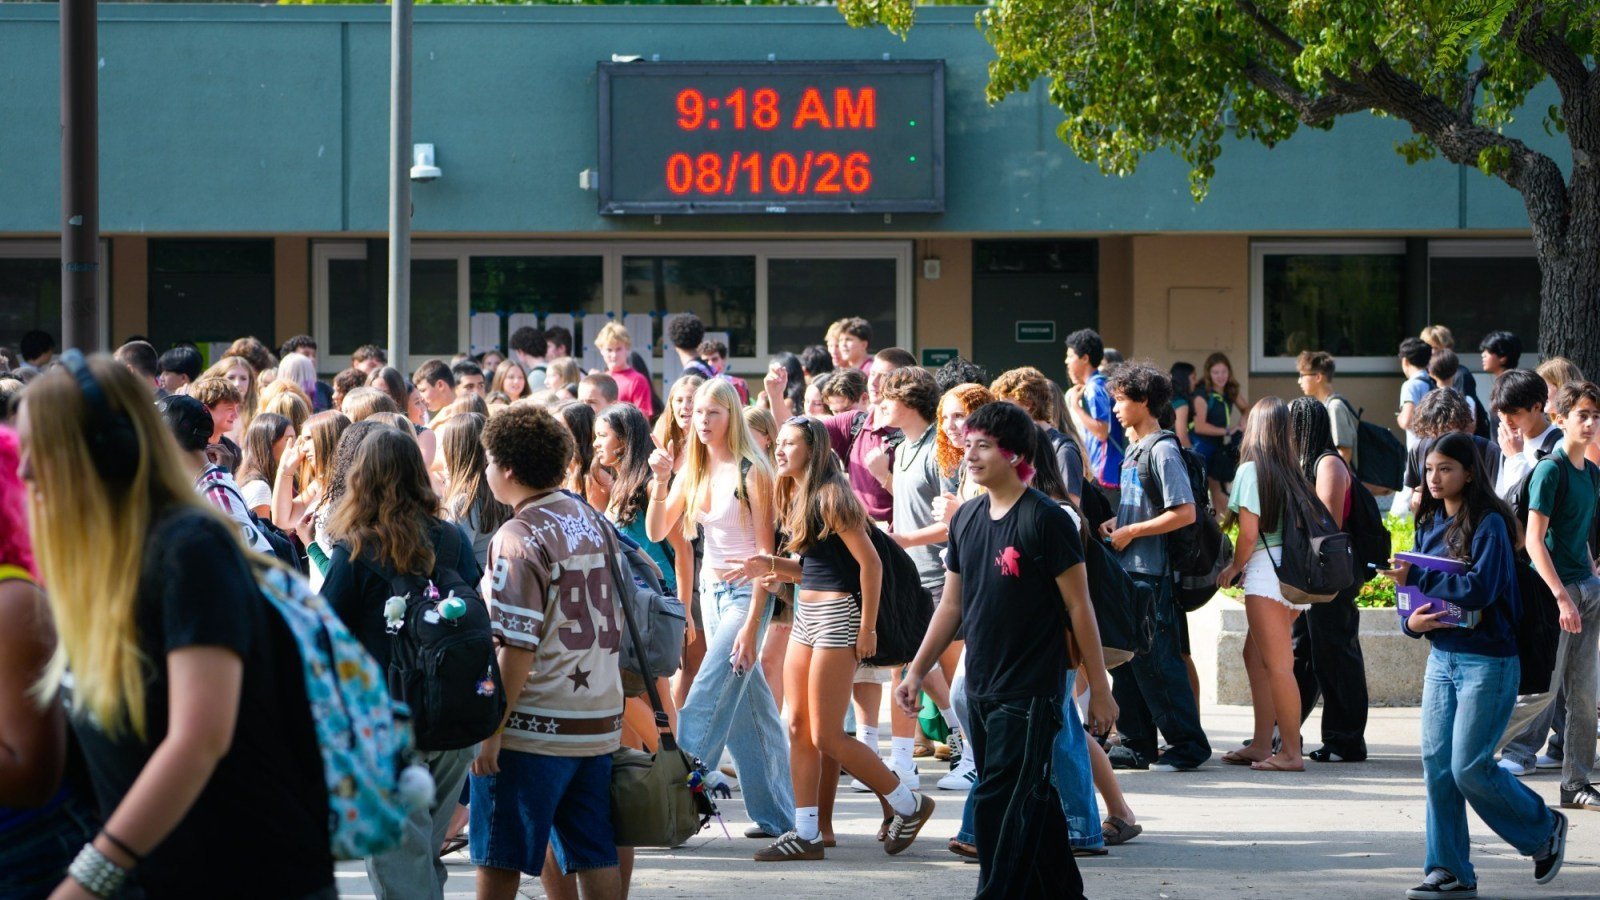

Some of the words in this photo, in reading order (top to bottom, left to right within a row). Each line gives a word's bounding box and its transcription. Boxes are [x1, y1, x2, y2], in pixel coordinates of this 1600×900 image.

[676, 88, 780, 130] 9:18
[792, 87, 876, 129] AM
[666, 151, 872, 195] 08/10/26
[558, 568, 621, 651] 99
